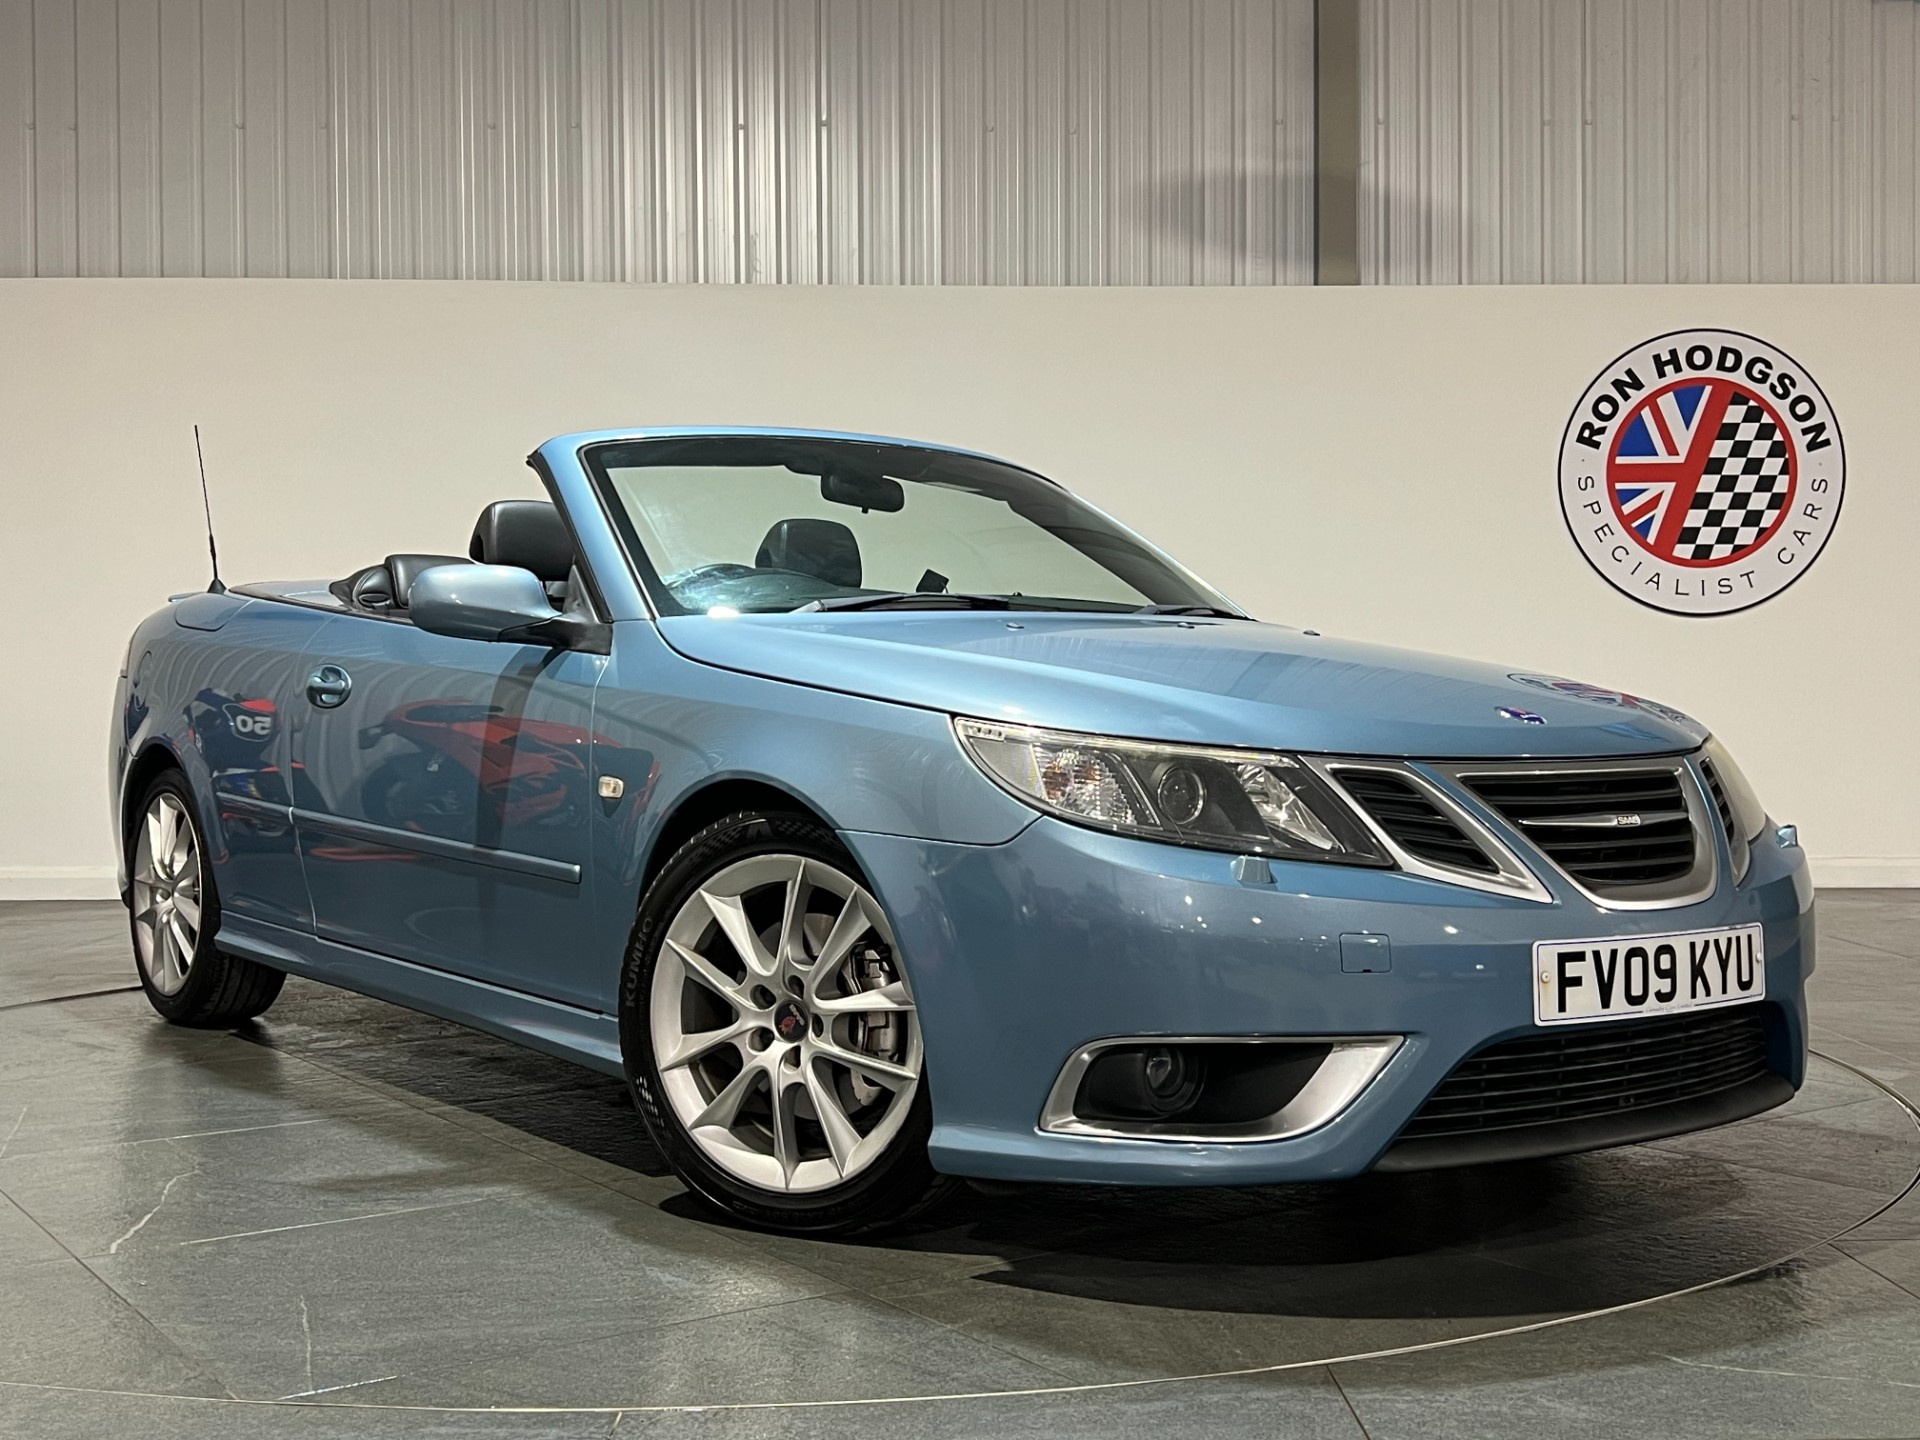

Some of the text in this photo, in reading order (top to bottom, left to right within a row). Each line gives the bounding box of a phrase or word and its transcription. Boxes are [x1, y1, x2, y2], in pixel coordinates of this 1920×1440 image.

[1575, 345, 1832, 453] RON HODGSON
[1577, 476, 1829, 596] SPECIALIST CARS
[625, 918, 653, 1008] KUMHO
[1557, 933, 1755, 1013] FV09 KYU
